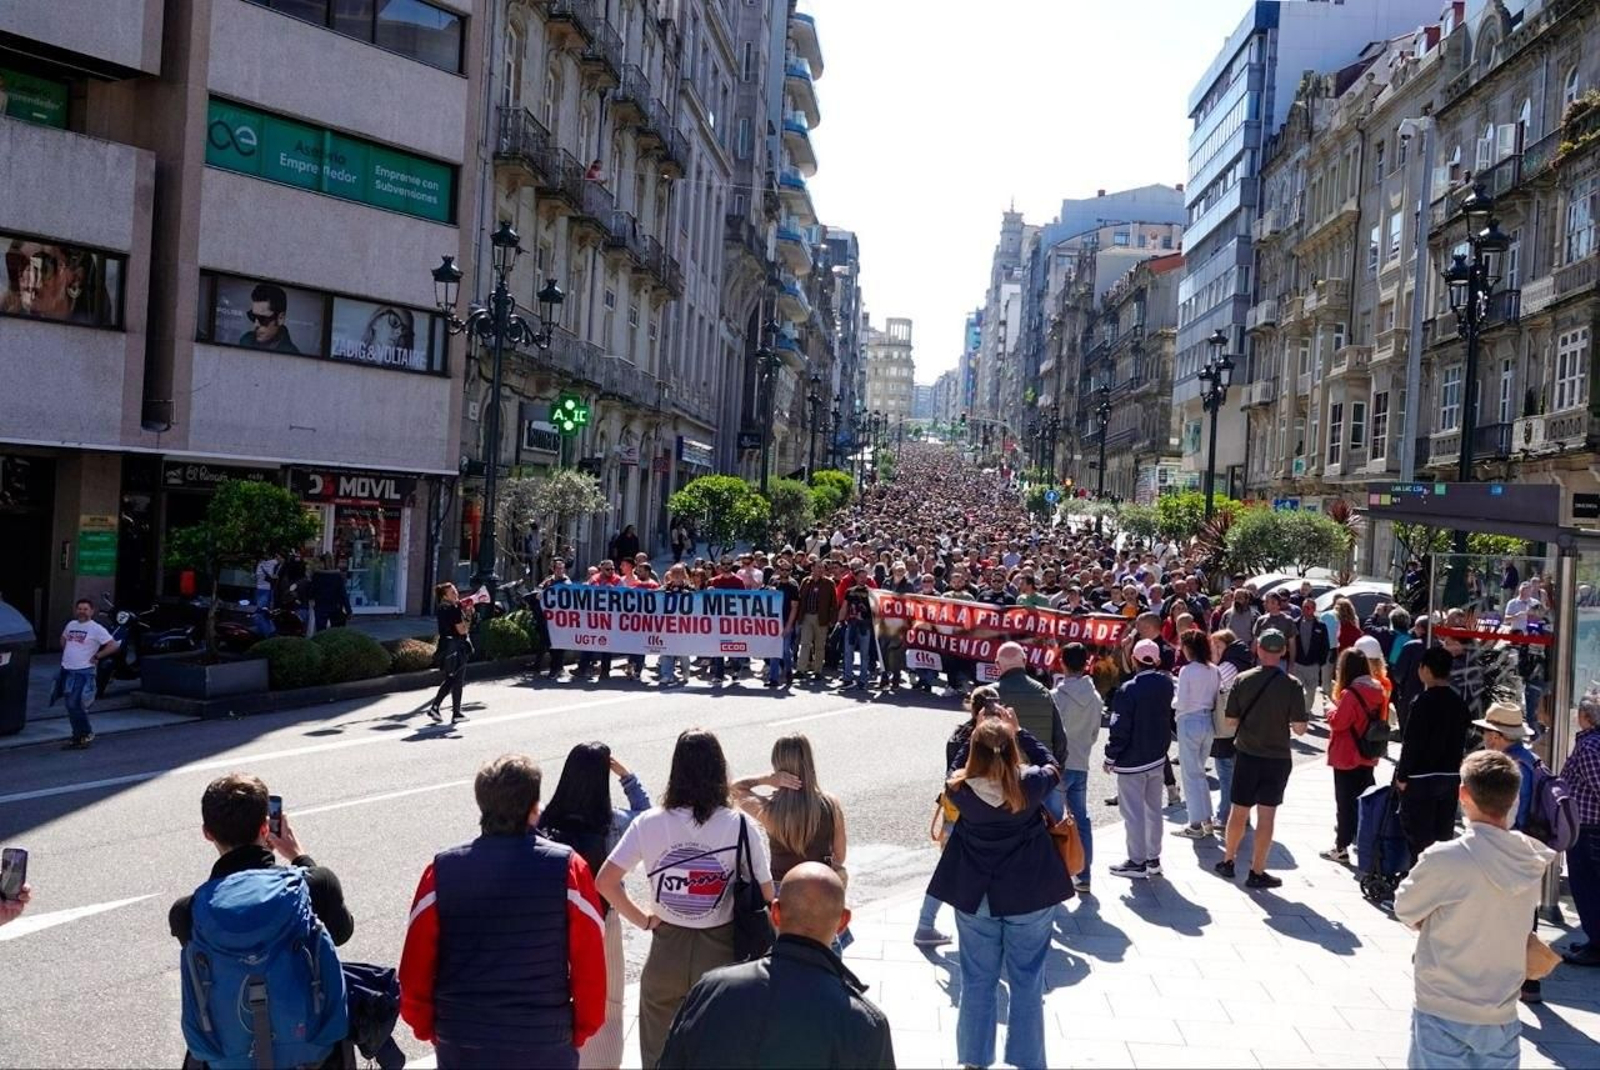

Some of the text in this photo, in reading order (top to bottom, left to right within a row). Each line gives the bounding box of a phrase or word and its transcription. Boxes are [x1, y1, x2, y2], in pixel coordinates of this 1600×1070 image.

[422, 179, 439, 191] con
[339, 476, 401, 499] MOVIL
[543, 587, 779, 617] COMERCIO DO METAL
[543, 610, 779, 636] POR UN CONVENIO DIGNO
[884, 599, 1121, 641] CONTRA A PRECARIEDADE
[575, 634, 597, 645] UGT
[906, 629, 991, 656] CONVENIO
